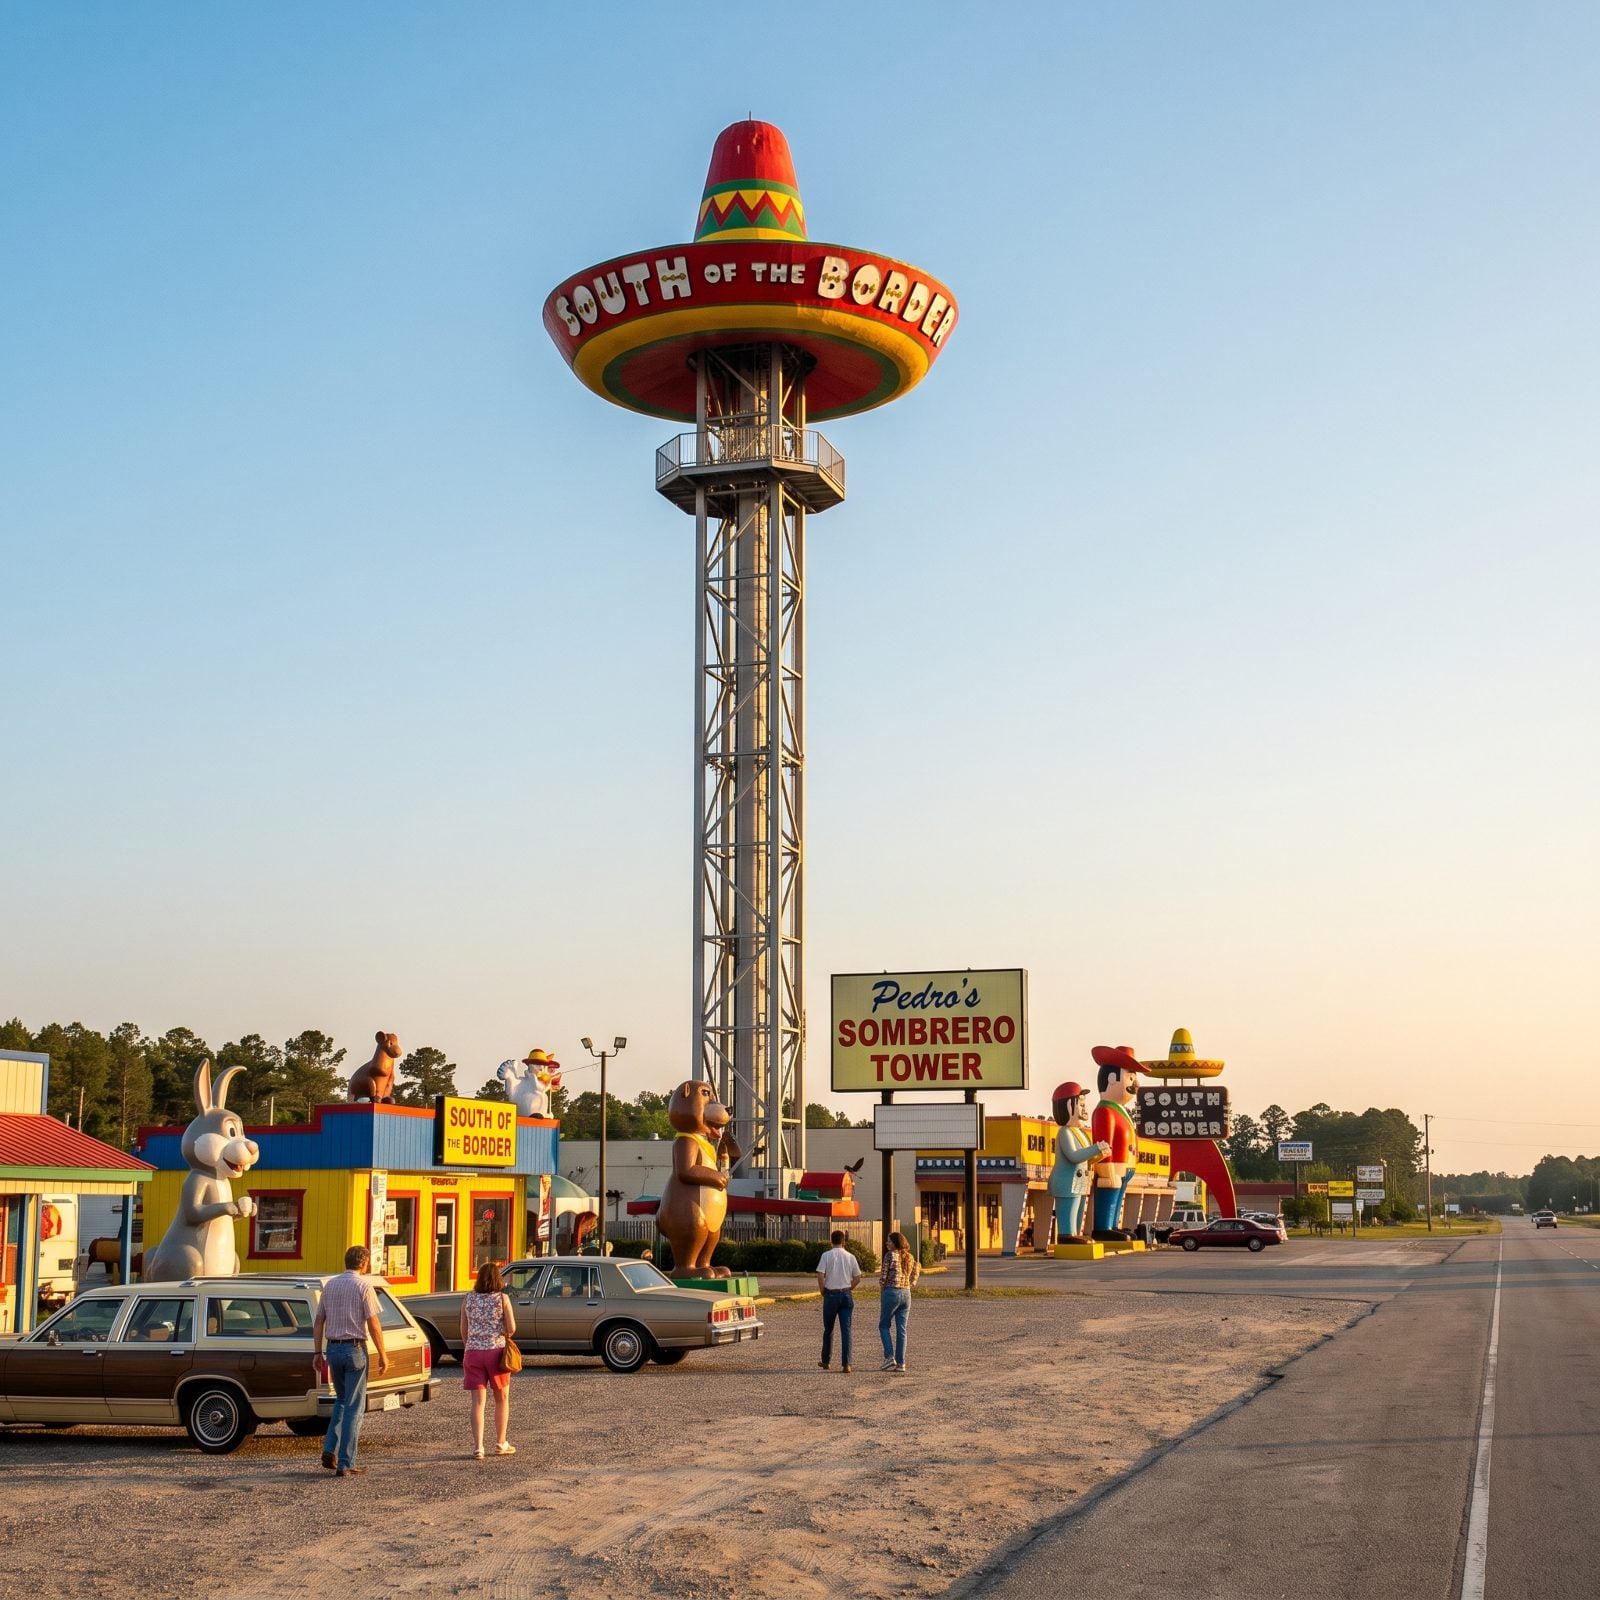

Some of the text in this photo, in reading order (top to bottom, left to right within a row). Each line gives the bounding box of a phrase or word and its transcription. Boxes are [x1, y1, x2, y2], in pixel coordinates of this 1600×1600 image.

[556, 255, 957, 348] SOUTH OF THE BORDER
[871, 977, 981, 1014] Pedro's
[838, 1015, 1016, 1048] SOMBRERO
[870, 1052, 983, 1082] TOWER
[1143, 1092, 1220, 1107] SOUTH
[450, 1106, 512, 1130] SOUTH OF
[1161, 1109, 1204, 1118] OF THE
[1144, 1121, 1222, 1136] BORDER
[447, 1134, 512, 1157] THE BORDER
